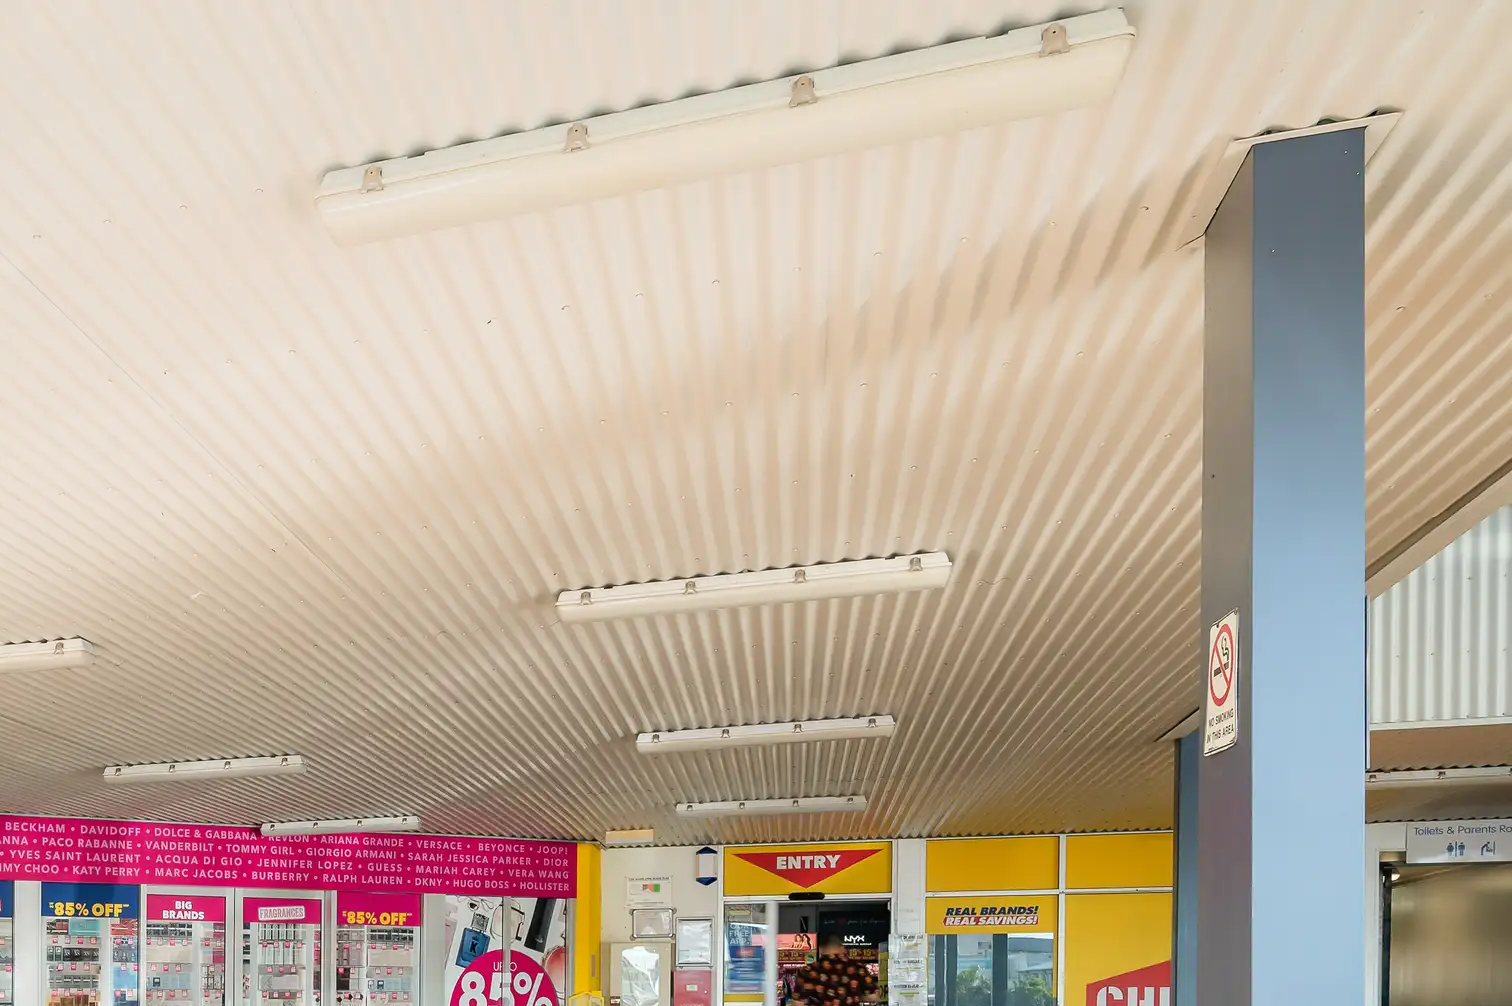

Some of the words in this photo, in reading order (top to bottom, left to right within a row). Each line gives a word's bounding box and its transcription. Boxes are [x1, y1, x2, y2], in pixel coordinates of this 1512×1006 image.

[1215, 708, 1234, 725] SMOKING
[1222, 723, 1235, 736] AREA
[1414, 826, 1444, 836] Toilets
[1446, 826, 1454, 835] &
[1457, 825, 1497, 834] Parents
[5, 821, 66, 833] BECKHAM
[80, 825, 141, 837] DAVIDOFF
[154, 828, 191, 838] DOLCE
[194, 829, 202, 838] &
[205, 830, 257, 841] GABBANA
[268, 835, 310, 843] REVLON
[320, 835, 359, 845] ARIANA
[363, 837, 404, 847] GRANDE
[416, 840, 463, 850] VERSACE
[478, 843, 525, 853] BEYONCE
[537, 845, 568, 855] JOOP!
[42, 837, 73, 848] PACO
[77, 839, 133, 850] RABANNE
[145, 840, 213, 852] VANDERBILT
[225, 844, 267, 854] TOMMY
[270, 845, 295, 855] GIRL
[305, 847, 352, 858] GIORGIO
[355, 849, 397, 860] ARMANI
[408, 852, 443, 862] SARAH
[447, 853, 489, 864] JESSICA
[492, 855, 532, 866] PARKER
[544, 858, 569, 867] DIOR
[9, 849, 40, 860] YVES
[45, 851, 82, 861] SAINT
[86, 852, 141, 863] LAURENT
[155, 855, 198, 865] ACQUA
[203, 856, 216, 865] DI
[221, 856, 243, 866] GIO
[257, 858, 313, 869] JENNIFER
[317, 861, 353, 871] LOPEZ
[367, 862, 402, 872] GUESS
[415, 865, 458, 876] MARIAH
[462, 866, 496, 877] CAREY
[508, 868, 535, 878] VERA
[538, 869, 569, 880] WANG
[776, 854, 841, 871] ENTRY
[24, 864, 60, 874] CHOO
[72, 865, 101, 876] KATY
[105, 866, 141, 877] PERRY
[154, 868, 189, 878] MARC
[192, 869, 238, 879] JACOBS
[251, 871, 310, 882] BURBERRY
[322, 873, 357, 883] RALPH
[361, 875, 403, 885] LAUREN
[414, 877, 443, 887] DKNY
[453, 878, 481, 889] HUGO
[484, 879, 510, 890] BOSS
[520, 881, 570, 891] HOLLISTER
[54, 902, 89, 916] 85%
[91, 903, 123, 917] OFF
[175, 900, 193, 910] BIG
[945, 907, 977, 916] REAL
[979, 906, 1039, 916] BRANDS!
[162, 910, 205, 920] BRANDS
[259, 908, 304, 919] FRAGRANCES
[347, 911, 378, 925] 85%
[379, 912, 407, 926] OFF
[944, 916, 976, 926] REAL
[977, 915, 1038, 925] SAVINGS!
[844, 935, 865, 943] NYX
[469, 940, 478, 954] K
